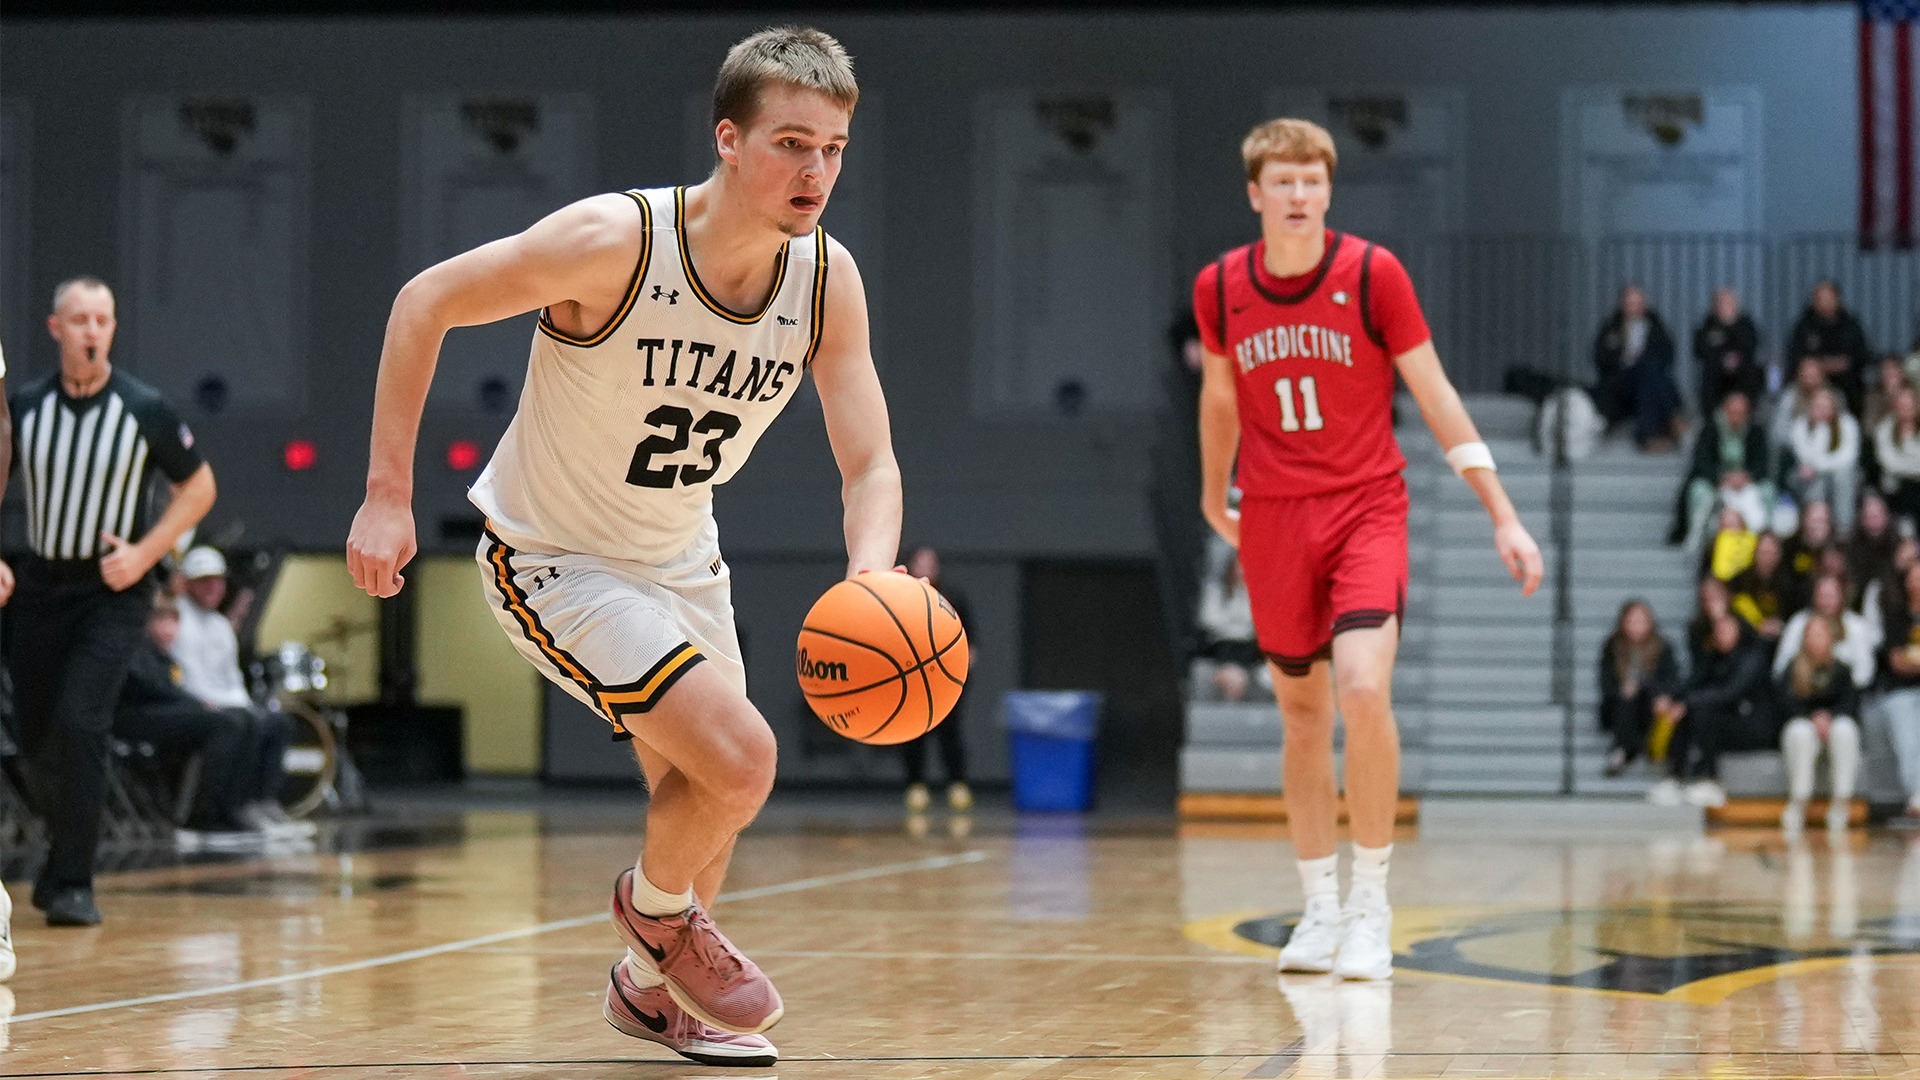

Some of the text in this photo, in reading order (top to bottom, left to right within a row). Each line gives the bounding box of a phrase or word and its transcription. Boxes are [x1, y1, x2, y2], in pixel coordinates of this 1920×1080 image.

[636, 338, 795, 402] TITANS
[1235, 324, 1354, 375] BENEDICTINE
[1274, 376, 1324, 432] 11
[625, 404, 742, 489] 23
[797, 648, 849, 681] lson
